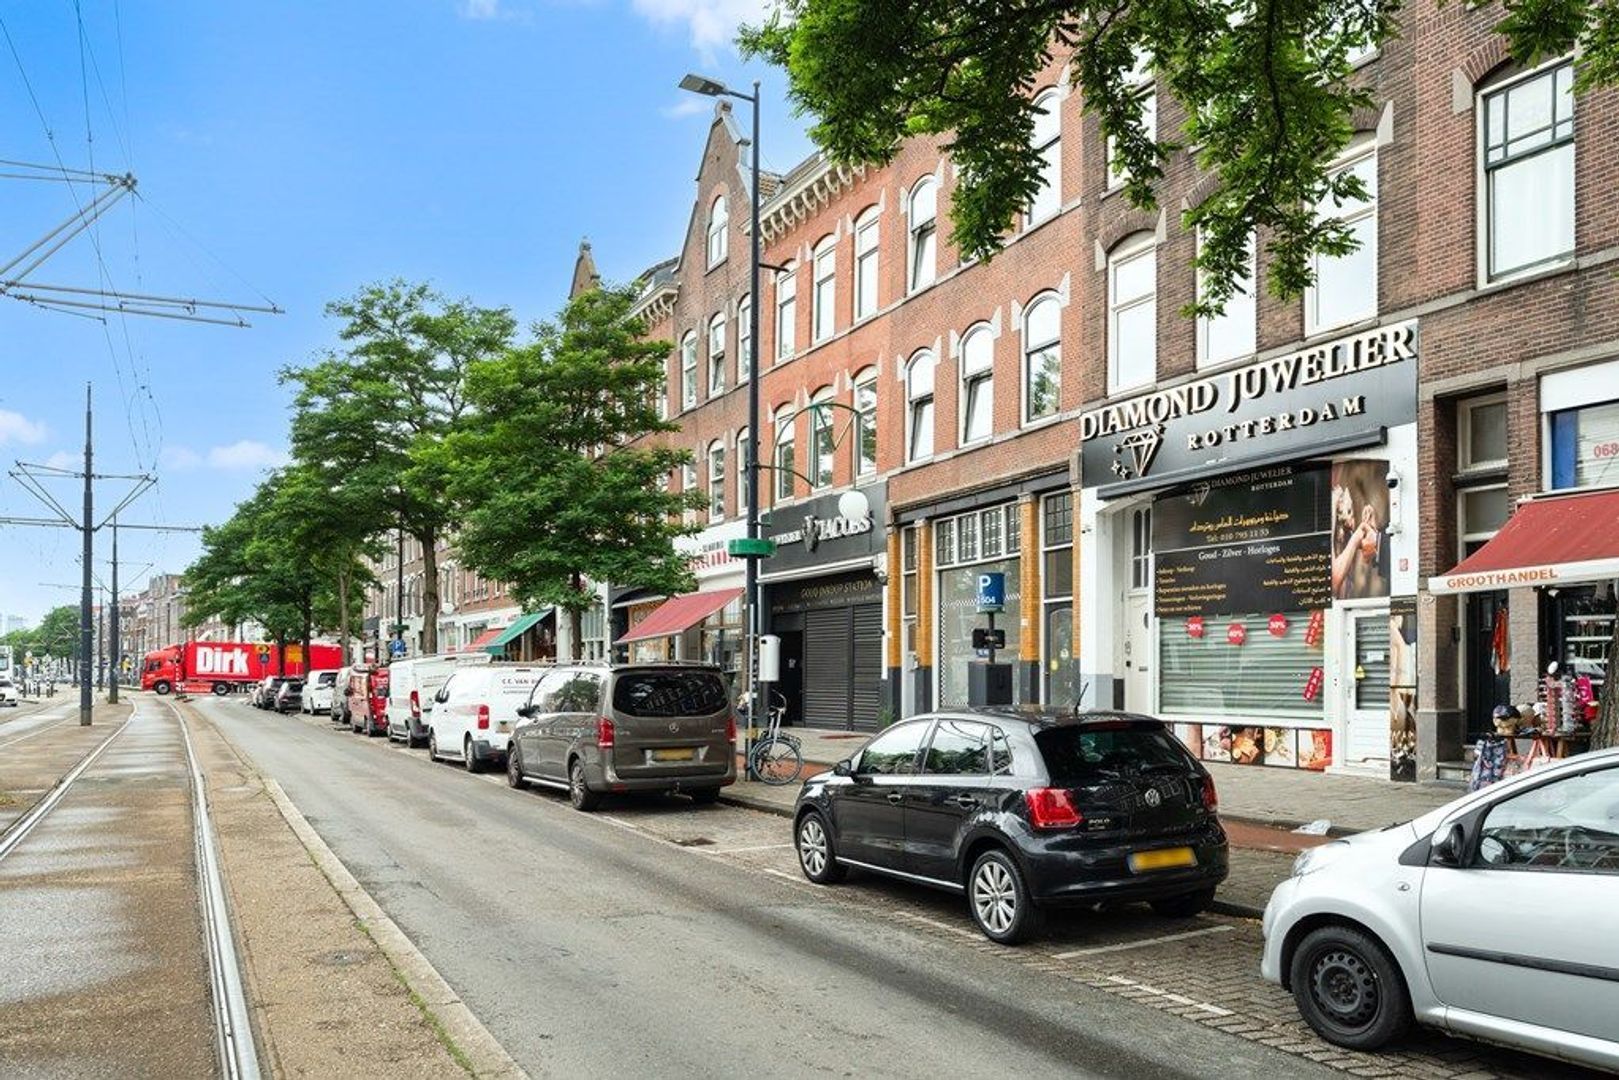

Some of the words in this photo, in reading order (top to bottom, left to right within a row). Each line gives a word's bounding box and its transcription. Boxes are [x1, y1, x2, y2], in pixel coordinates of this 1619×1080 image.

[1079, 381, 1217, 442] DIAMOND
[1227, 326, 1417, 412] JUWELIER
[1187, 395, 1365, 450] ROTTERDAM
[1211, 474, 1250, 488] DIAMOND
[1250, 466, 1292, 482] JUWELIER
[979, 574, 992, 594] P
[1446, 567, 1559, 589] GROOTHANDEL
[196, 646, 250, 675] Dirk
[1304, 667, 1321, 700] SALE
